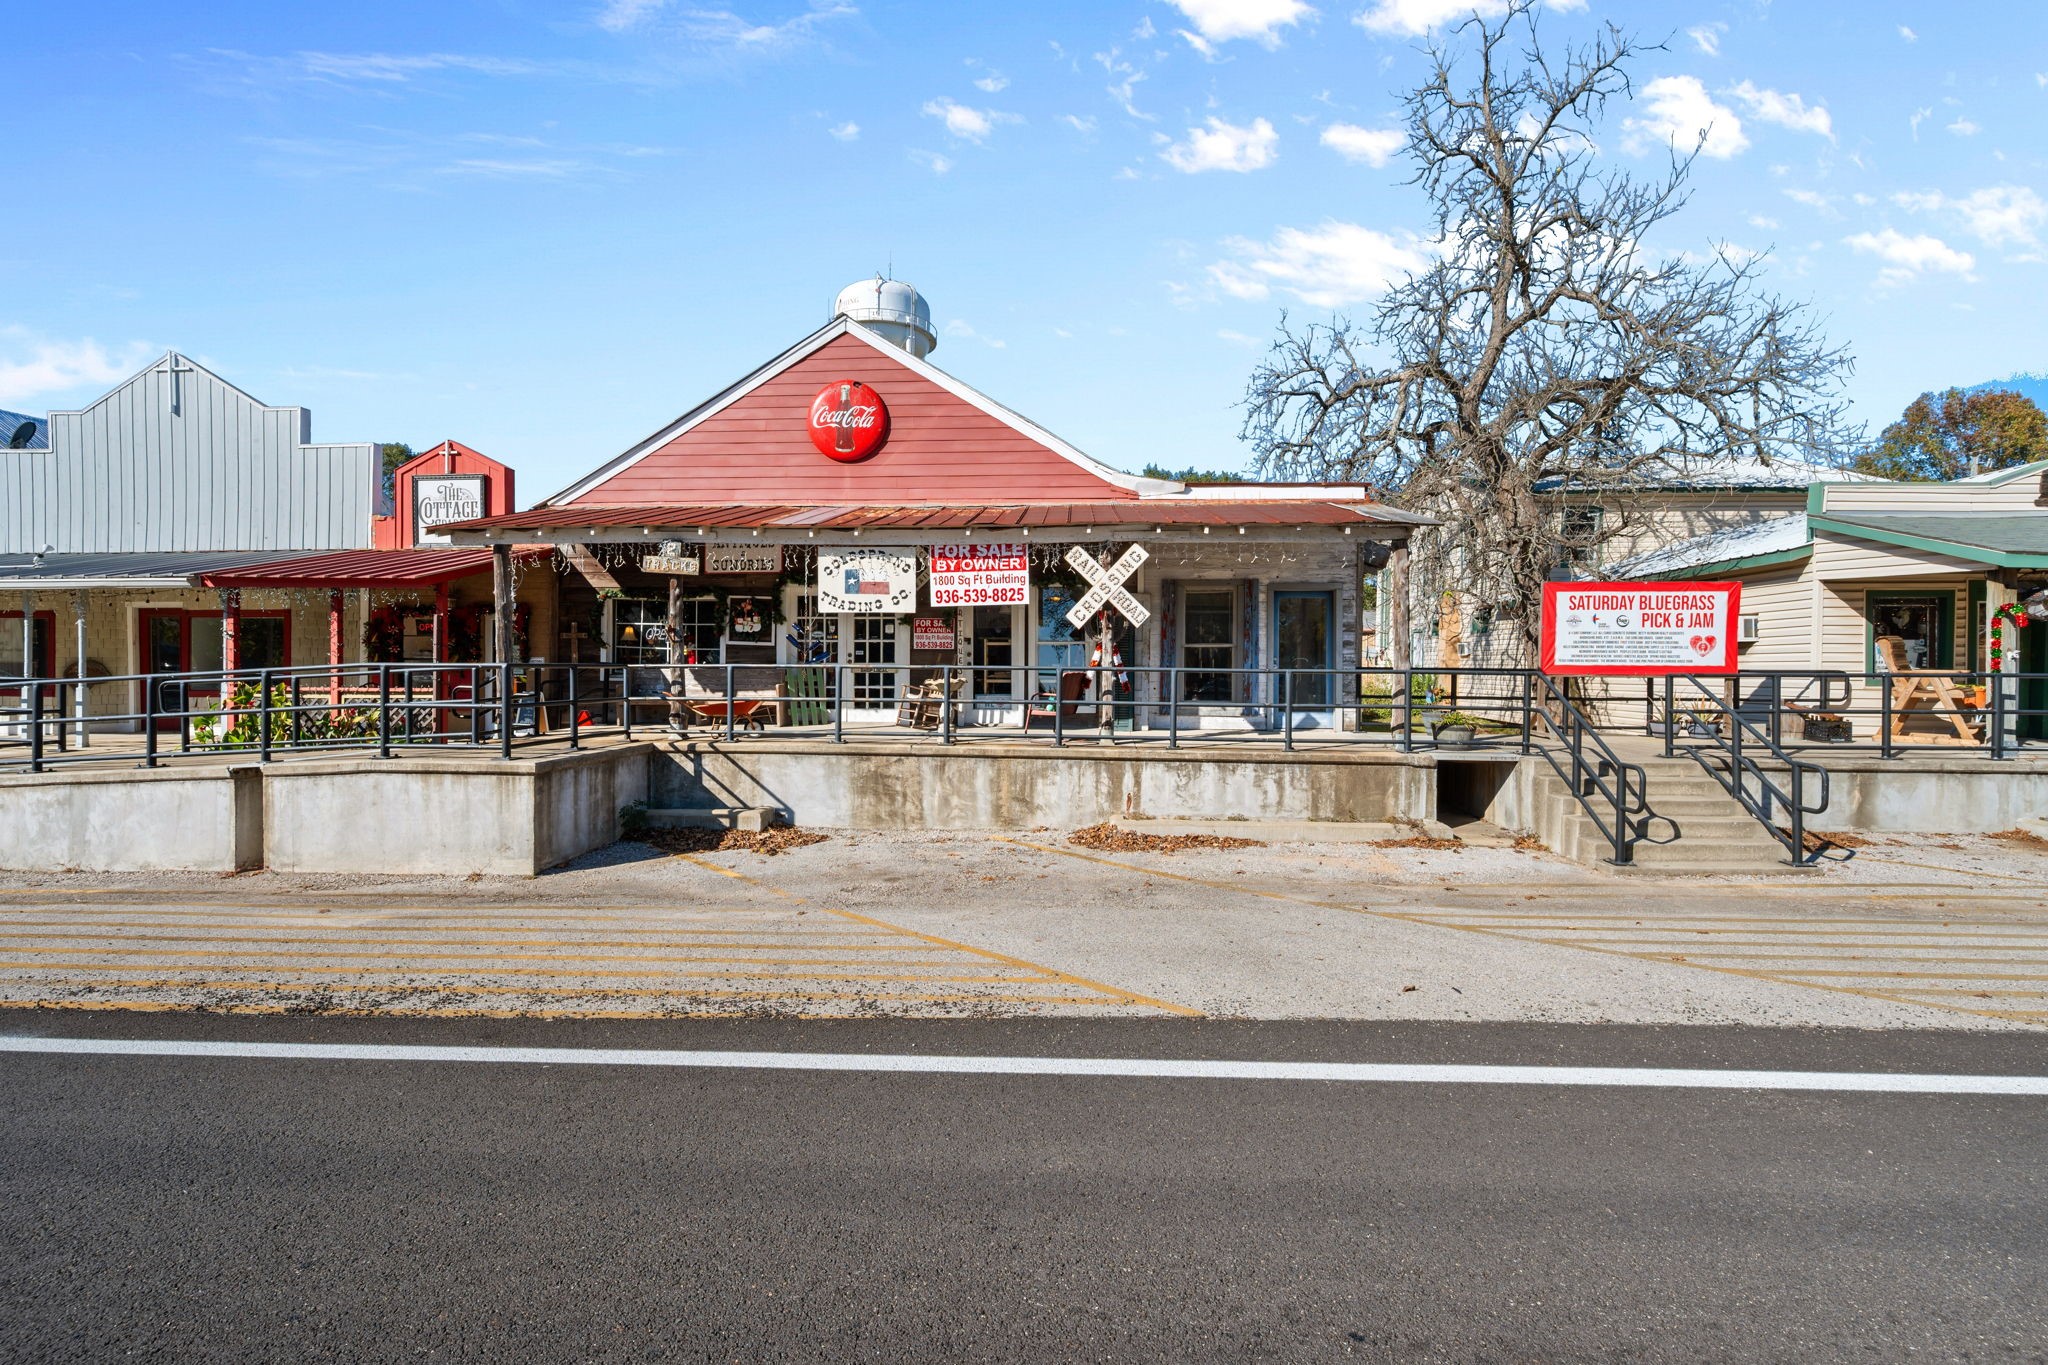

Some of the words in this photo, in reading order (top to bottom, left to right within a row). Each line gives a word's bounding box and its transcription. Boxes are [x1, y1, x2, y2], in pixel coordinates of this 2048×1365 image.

[812, 405, 877, 428] Coca-Cola
[437, 483, 463, 501] THE
[419, 497, 479, 525] COTTAGE
[934, 544, 971, 557] FOR
[977, 544, 1024, 557] SALE
[645, 559, 698, 571] TRACKS
[713, 560, 774, 571] SUNDRIES
[824, 549, 911, 573] COLDSPRING
[936, 560, 957, 571] BY
[961, 558, 1021, 570] OWNER
[1069, 549, 1099, 582] RAIL
[933, 576, 955, 586] 1800
[958, 575, 971, 587] Sq
[973, 574, 983, 584] Ft
[986, 573, 1026, 585] Building
[1073, 551, 1142, 622] CROSSING
[821, 591, 883, 611] TRADING
[891, 589, 912, 606] CO.
[935, 587, 1025, 604] 936-539-8825
[1568, 595, 1635, 610] SATURDAY
[1639, 595, 1715, 610] BLUEGRASS
[1112, 591, 1147, 624] ROAD
[915, 619, 931, 627] FOR
[1641, 613, 1673, 628] PICK
[1675, 613, 1684, 628] &
[1688, 613, 1714, 628] JAM
